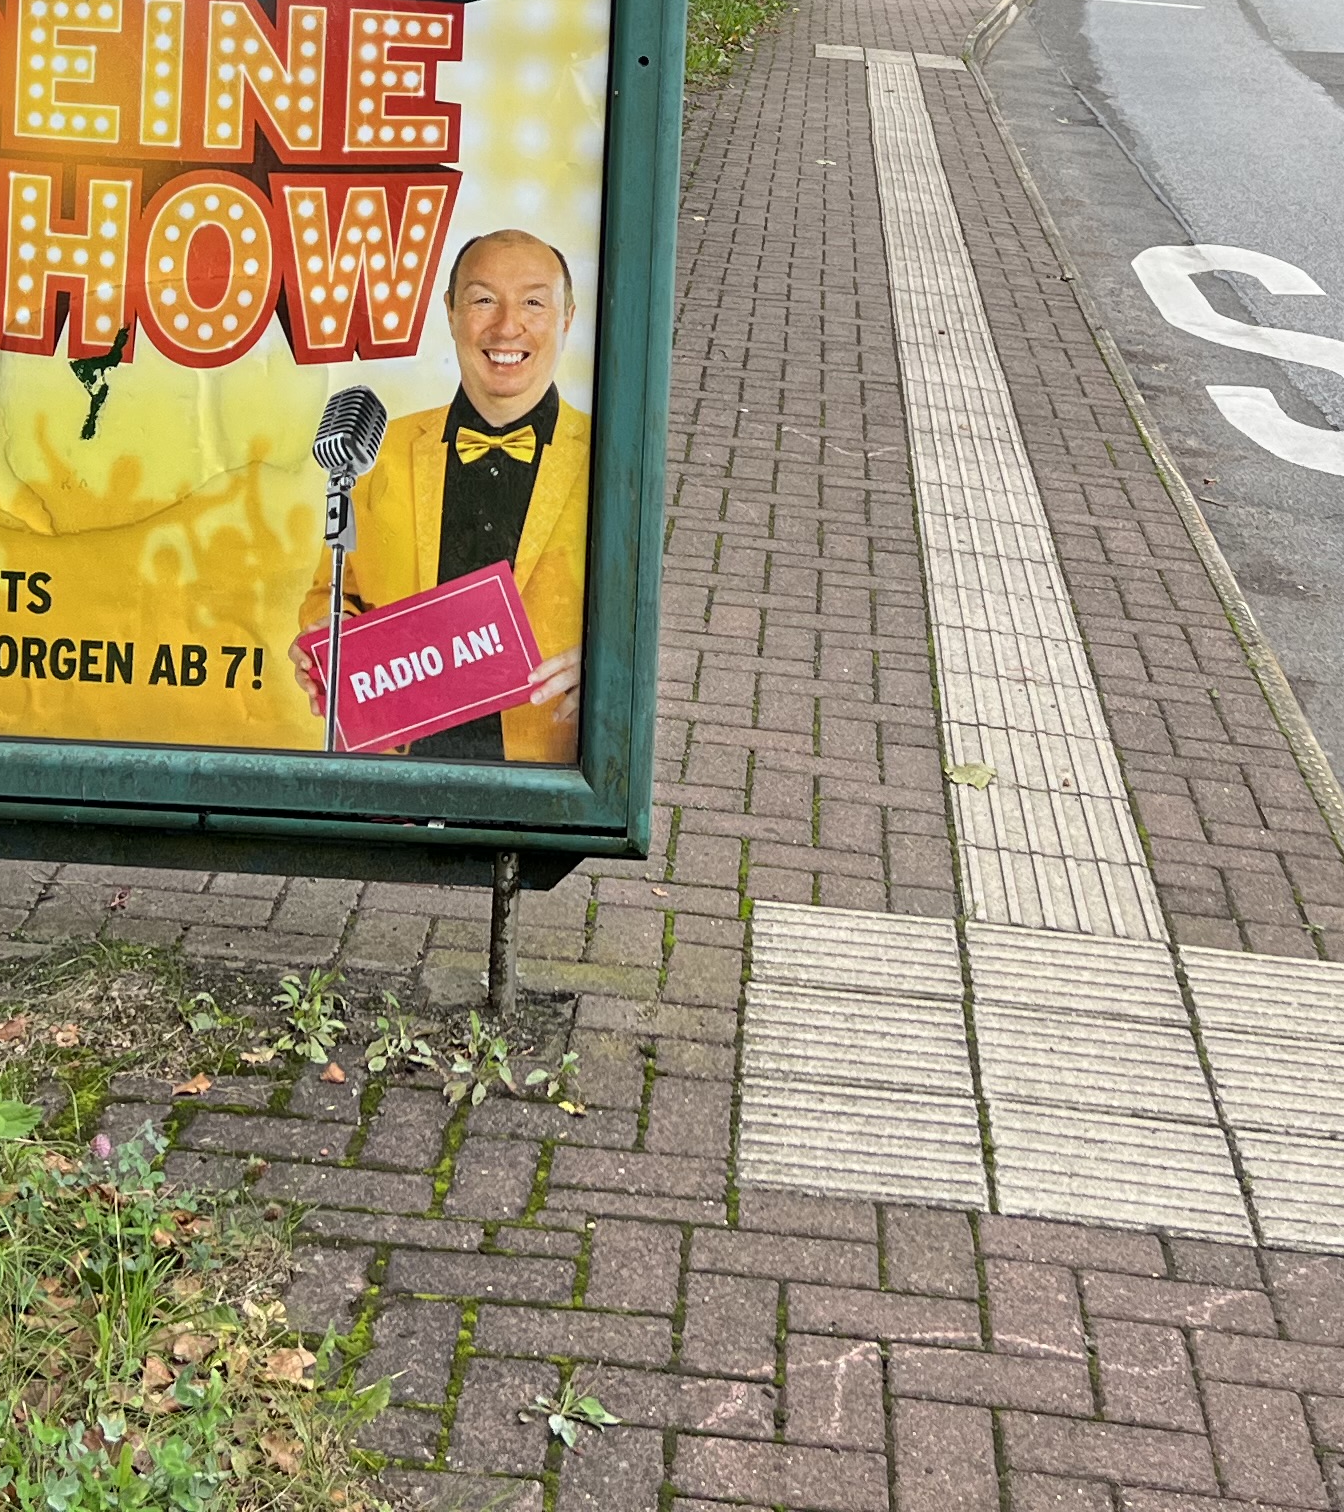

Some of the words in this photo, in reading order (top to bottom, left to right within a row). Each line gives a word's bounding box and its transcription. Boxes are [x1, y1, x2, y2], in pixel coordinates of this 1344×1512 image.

[149, 640, 209, 686] AB
[222, 644, 264, 689] 7!
[349, 646, 443, 704] RADIO
[452, 623, 504, 668] AN!
